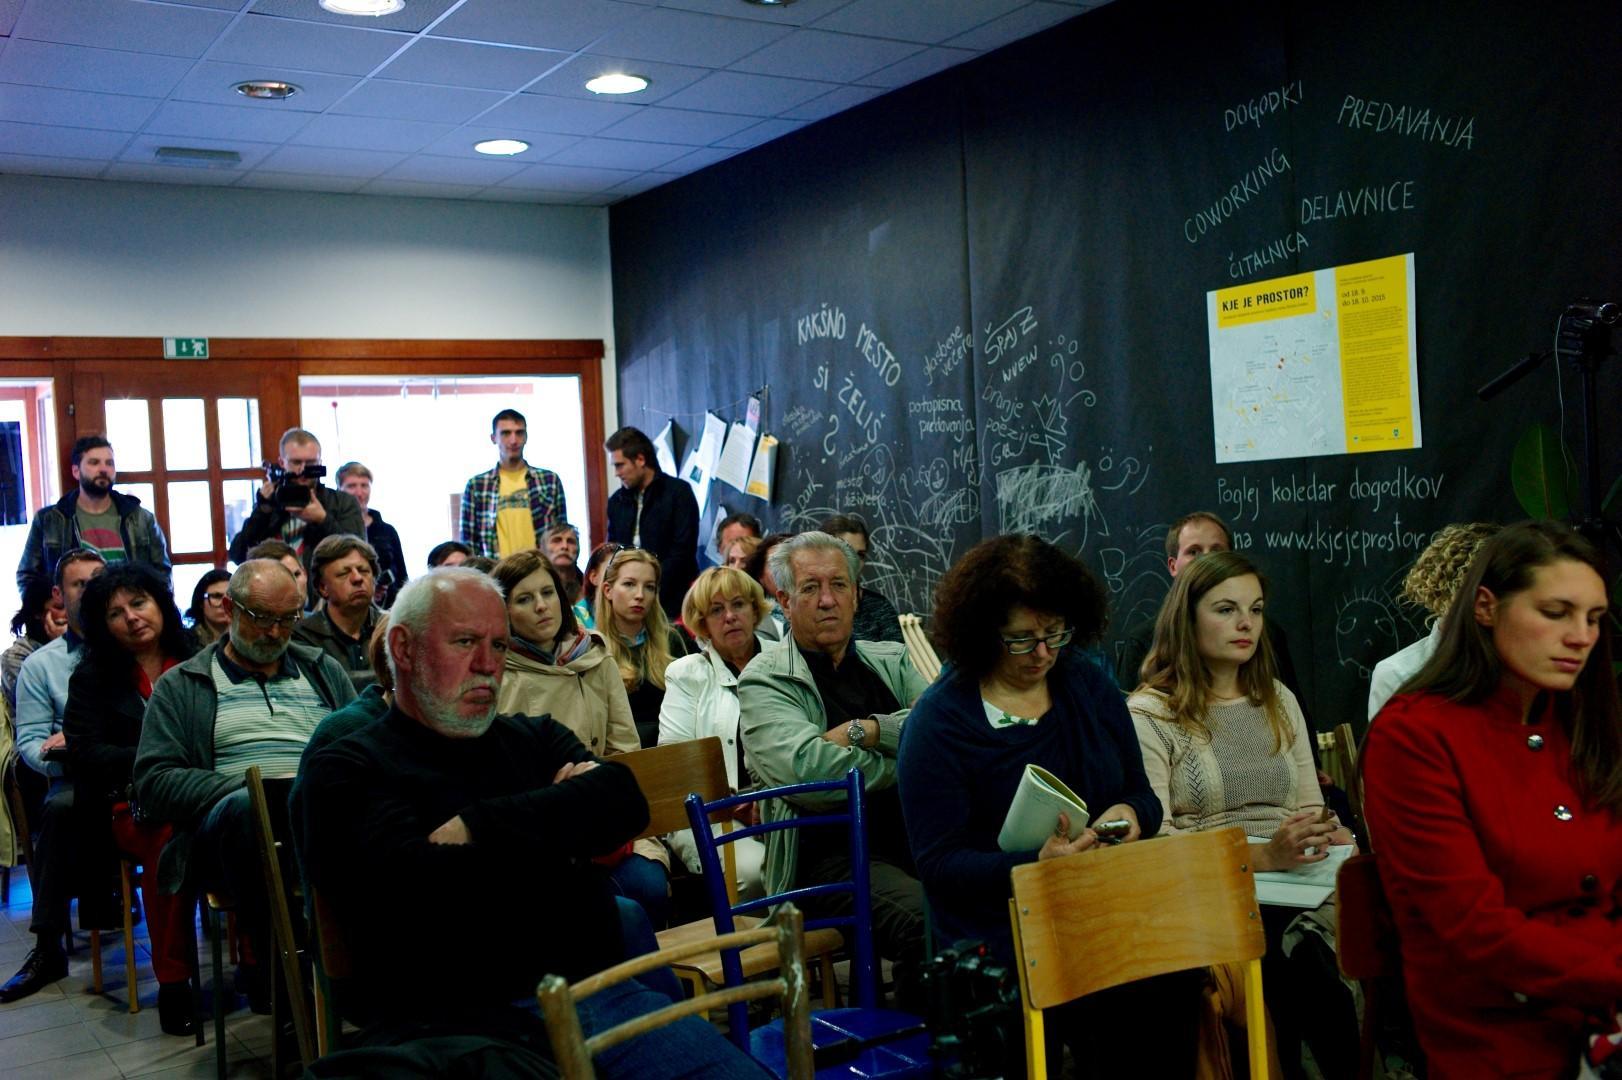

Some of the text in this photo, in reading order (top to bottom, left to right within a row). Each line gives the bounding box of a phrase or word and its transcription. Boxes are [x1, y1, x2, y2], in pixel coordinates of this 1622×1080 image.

[1224, 79, 1303, 132] DOGODKI
[1337, 95, 1475, 150] PREDAVANJA
[1184, 147, 1291, 244] COWORKING
[1301, 180, 1415, 225] DELAVNICE
[1229, 231, 1309, 279] ČITALNICA
[1222, 299, 1239, 312] KJE
[1243, 296, 1252, 308] JE
[1256, 286, 1309, 305] PROSTOR?
[798, 302, 901, 387] KAKŠNO MESTO
[813, 360, 830, 392] SI
[838, 370, 886, 445] ŽELIŠ
[1217, 465, 1444, 522] Poglej koledar dogodkov
[1232, 530, 1252, 551] na
